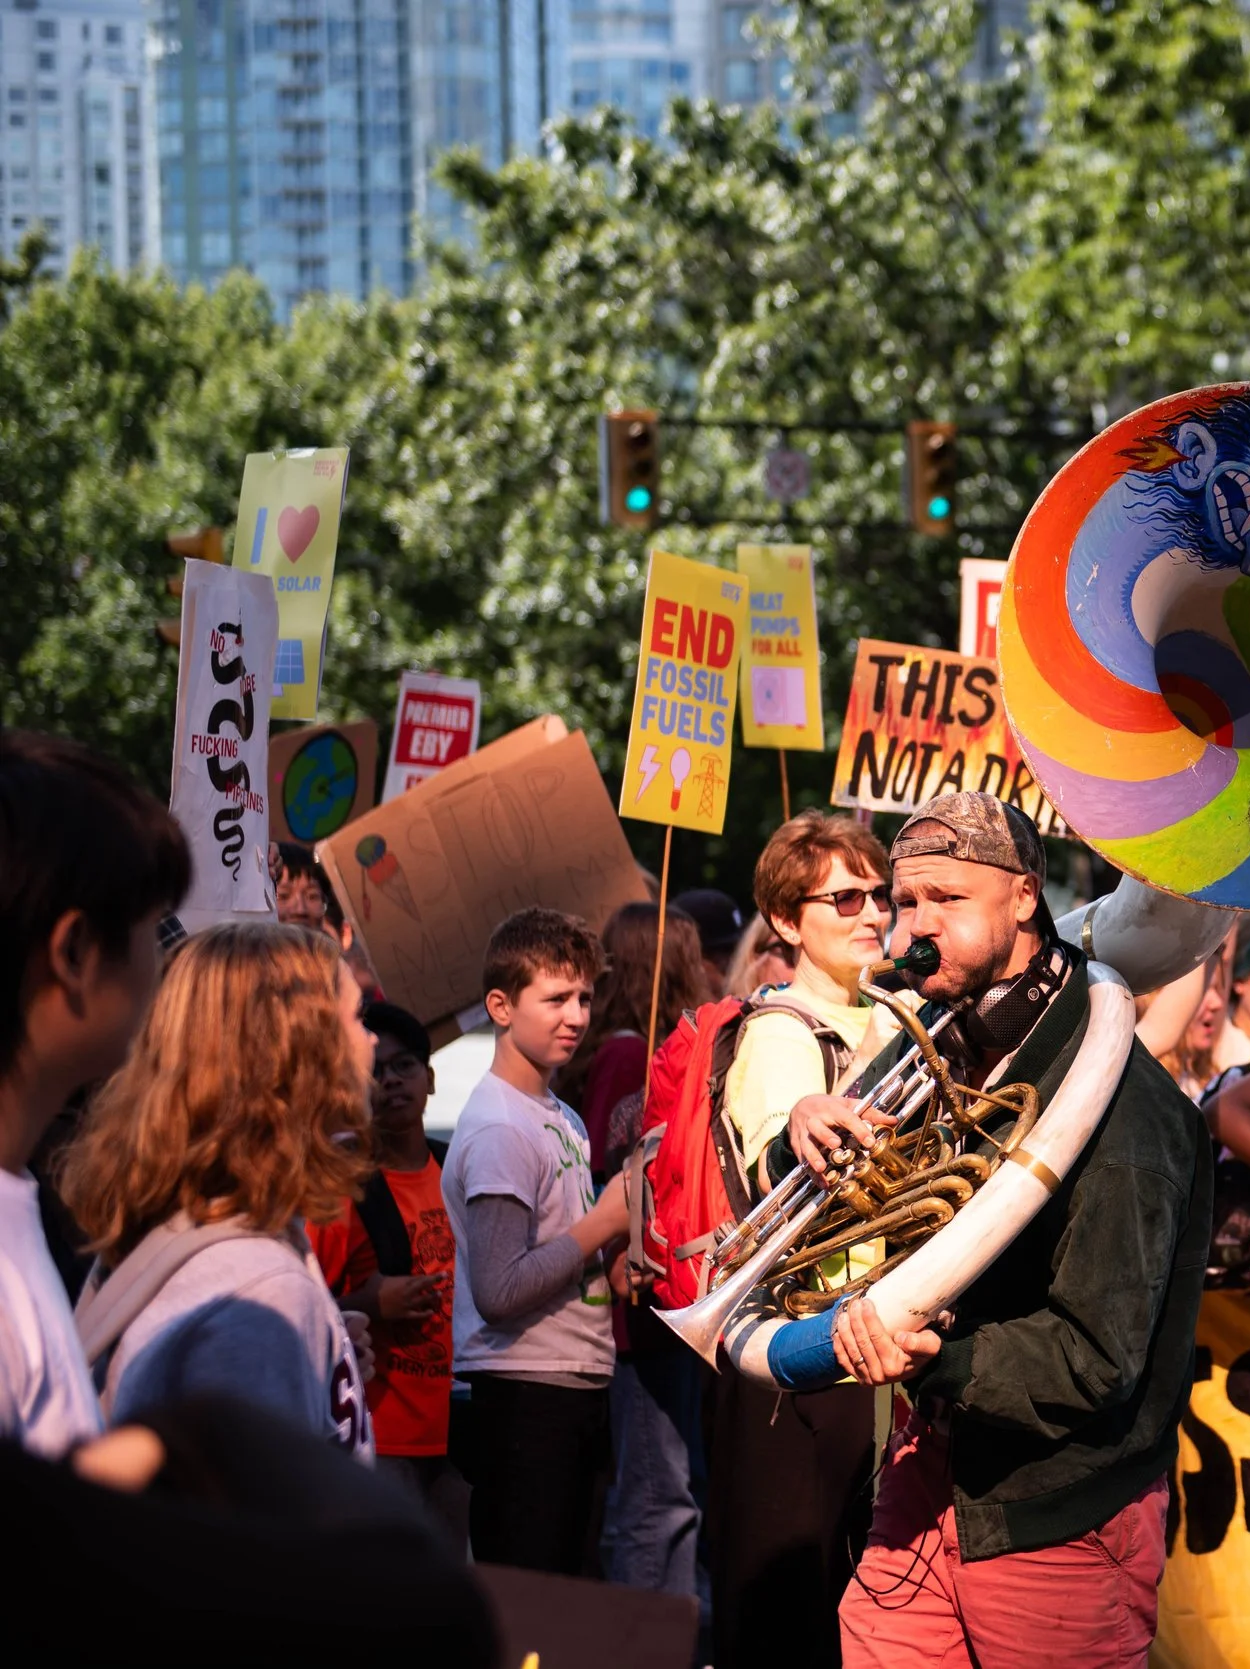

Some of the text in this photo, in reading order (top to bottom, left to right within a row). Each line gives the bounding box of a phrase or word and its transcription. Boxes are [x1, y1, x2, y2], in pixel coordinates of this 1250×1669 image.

[277, 576, 322, 592] SOLAR
[750, 593, 784, 611] HEAT
[210, 628, 226, 654] NO
[650, 597, 735, 669] END
[750, 616, 801, 637] PUMPS
[751, 638, 804, 658] FOR ALL
[645, 657, 729, 707] FOSSIL
[869, 655, 997, 728] THIS
[405, 699, 470, 731] PREMIER
[640, 696, 727, 747] FUELS
[191, 734, 238, 759] FUCKING
[409, 727, 455, 763] EBY
[850, 730, 1073, 835] NOT A DRIL
[407, 767, 564, 904] STOP
